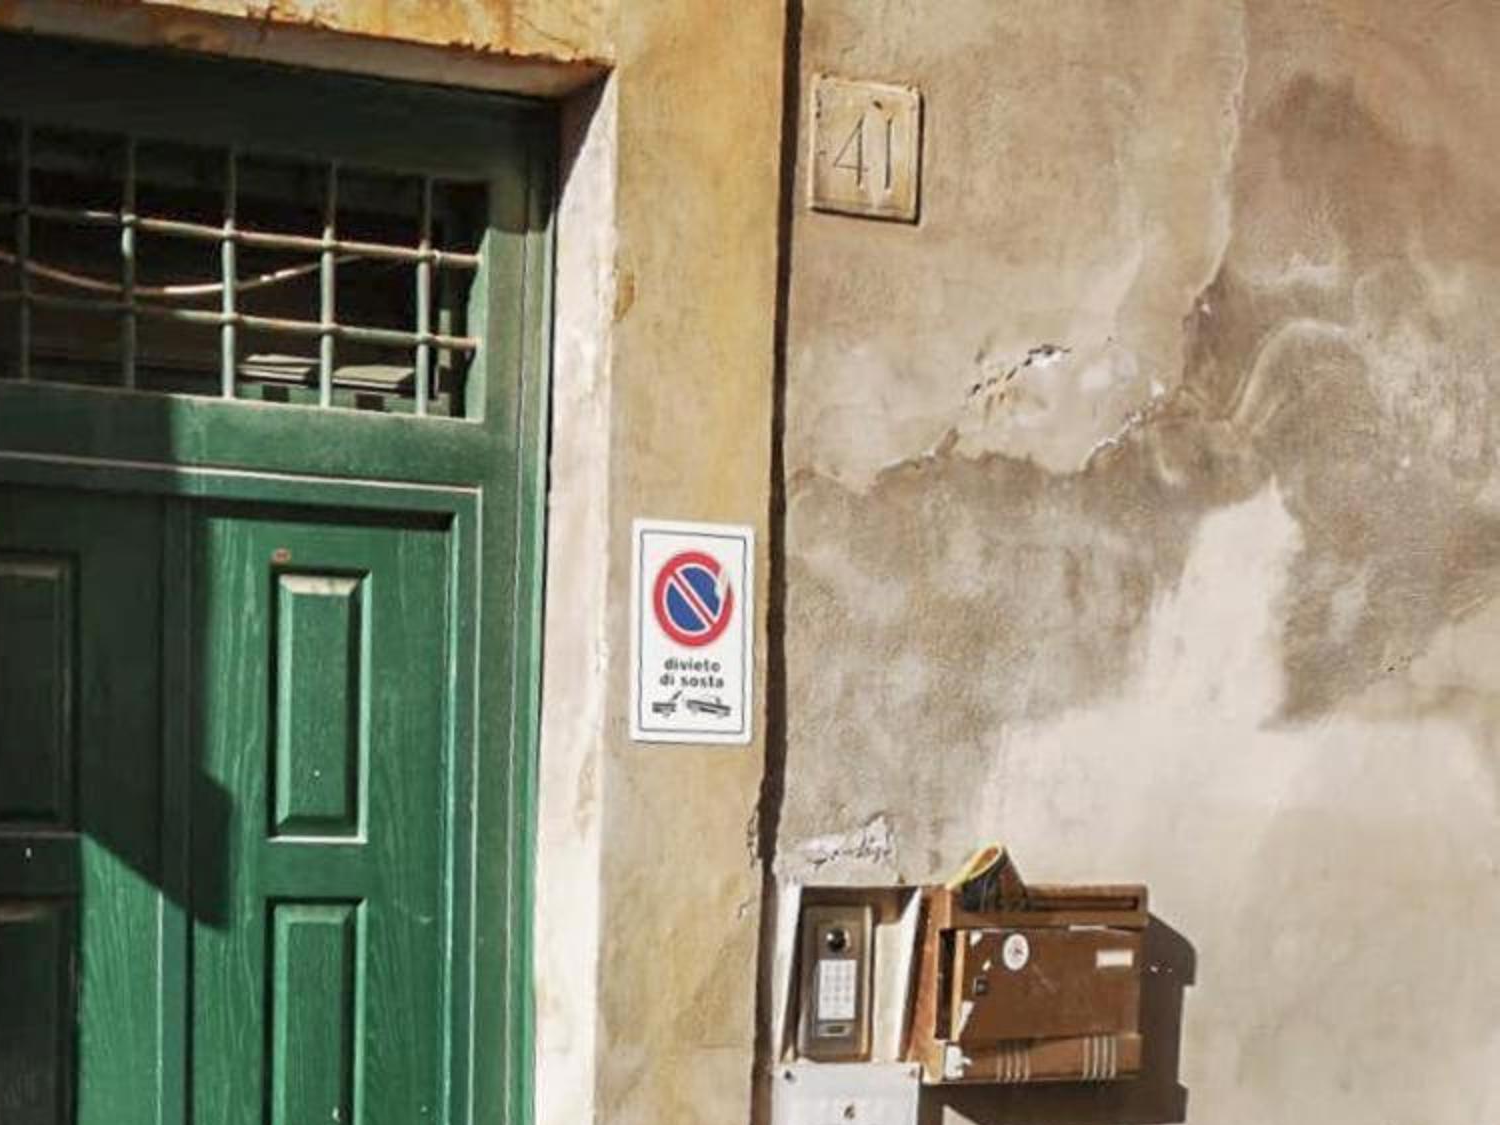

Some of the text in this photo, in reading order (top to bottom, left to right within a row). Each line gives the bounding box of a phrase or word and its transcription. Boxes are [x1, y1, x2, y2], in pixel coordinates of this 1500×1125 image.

[832, 112, 896, 190] 41
[664, 657, 721, 672] divieto
[660, 674, 725, 688] di sosta
